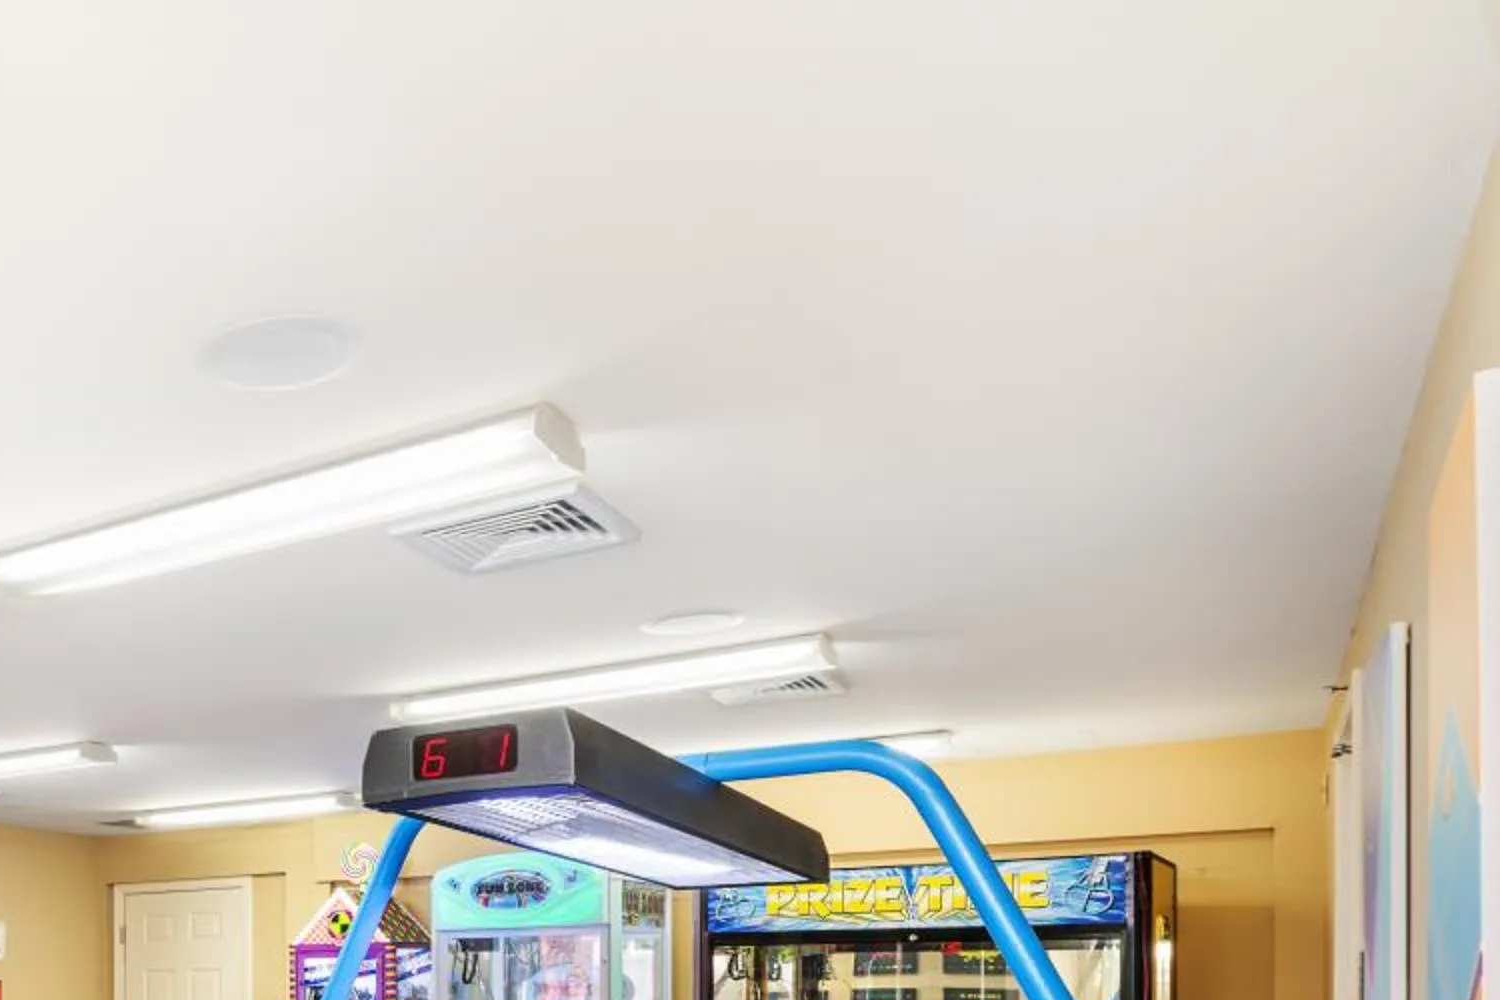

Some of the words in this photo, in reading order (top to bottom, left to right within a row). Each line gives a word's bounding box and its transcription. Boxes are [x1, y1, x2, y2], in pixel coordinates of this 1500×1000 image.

[420, 737, 448, 778] 6
[499, 733, 511, 769] 1
[766, 876, 902, 919] PRIZE
[917, 870, 1049, 912] TIE
